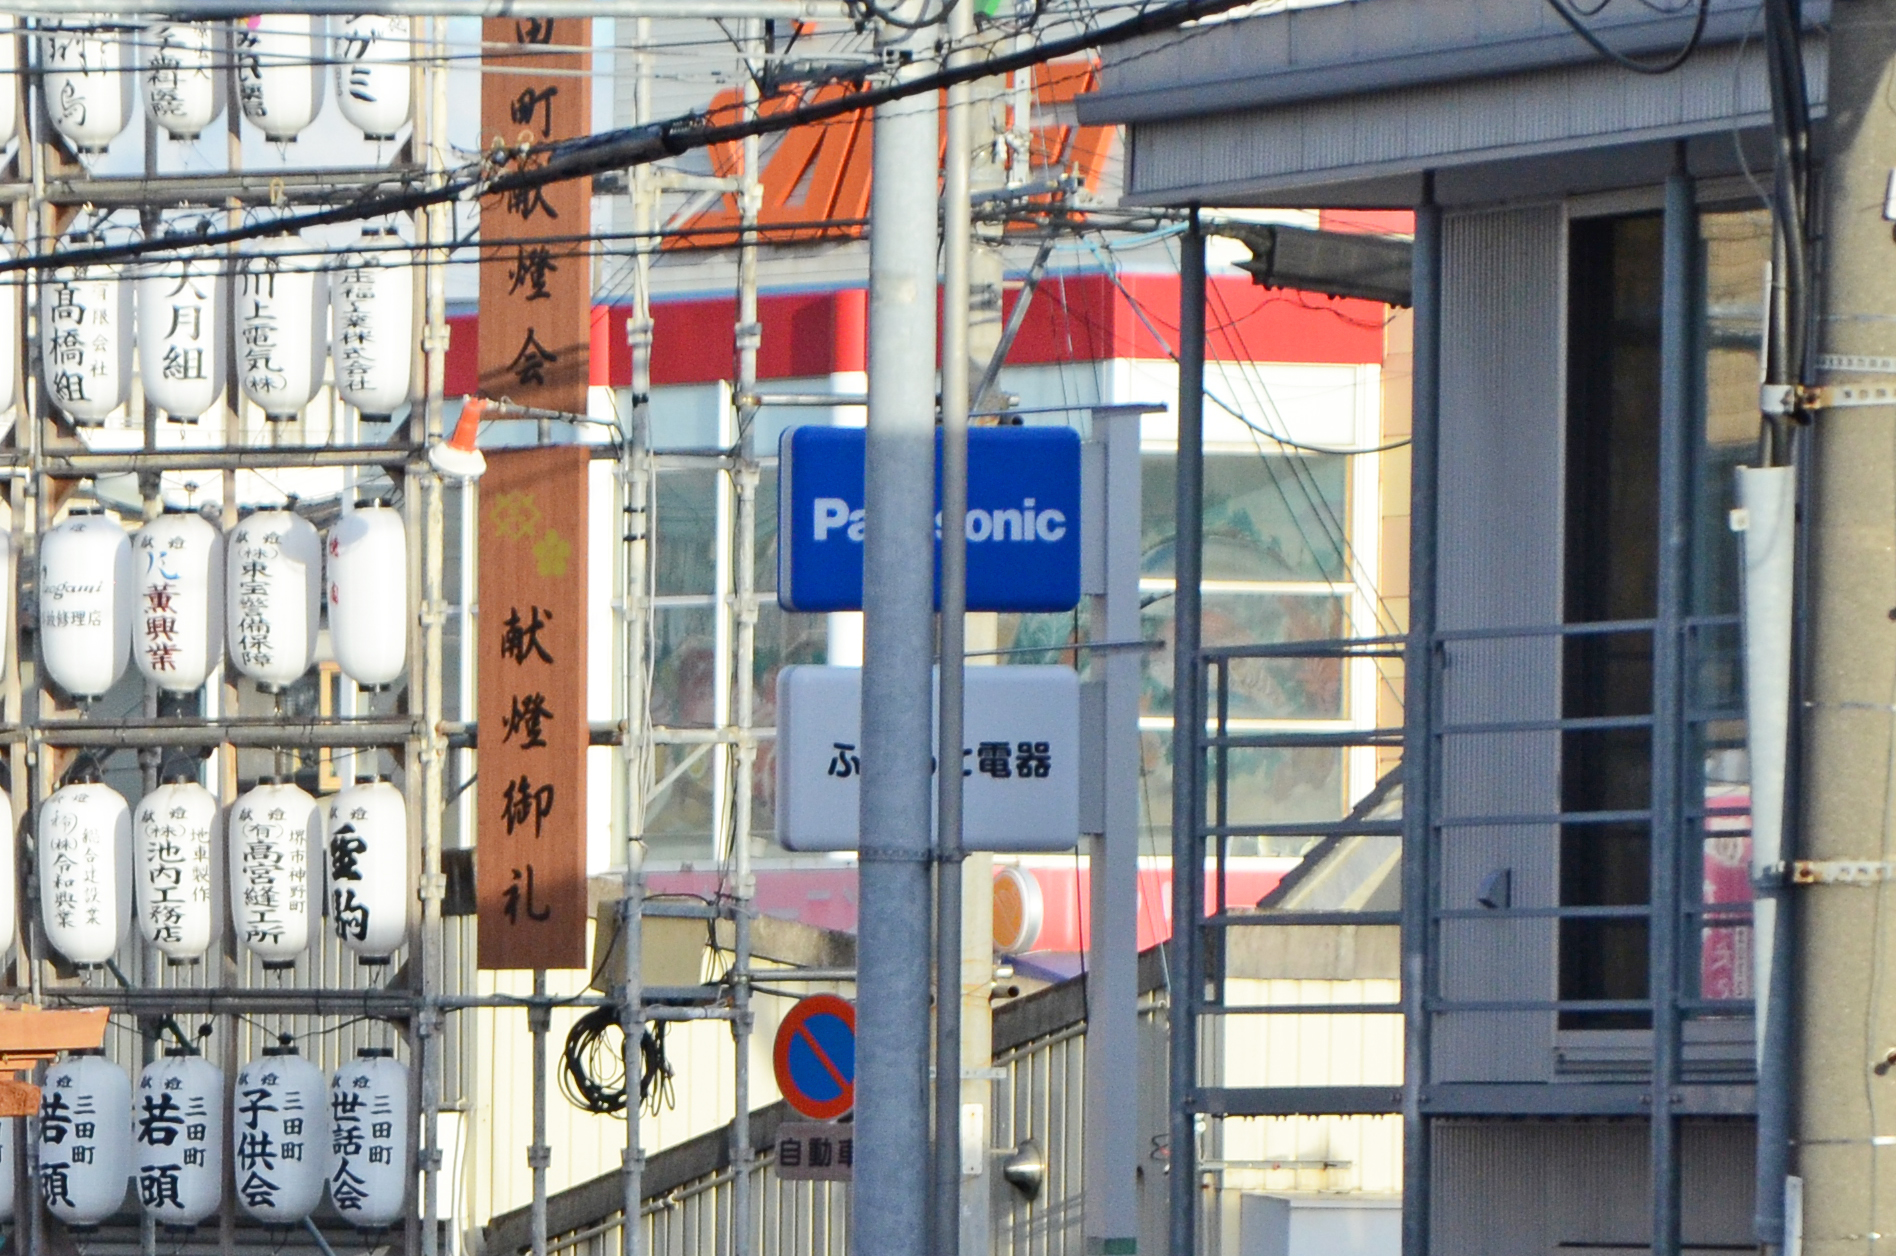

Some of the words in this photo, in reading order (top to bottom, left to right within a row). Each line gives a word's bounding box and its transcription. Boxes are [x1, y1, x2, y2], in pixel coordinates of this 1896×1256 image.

[813, 498, 1067, 541] Paonic
[501, 604, 555, 925] 献燈御礼
[828, 741, 1052, 779] ふ電器
[71, 1096, 96, 1165] 三田町
[137, 1093, 186, 1210] 若頭
[183, 1097, 208, 1168] 三田町
[236, 1088, 282, 1210] 子供会
[280, 1092, 306, 1163] 三田町
[329, 1093, 371, 1212] 世話人会
[367, 1096, 393, 1166] 三田町
